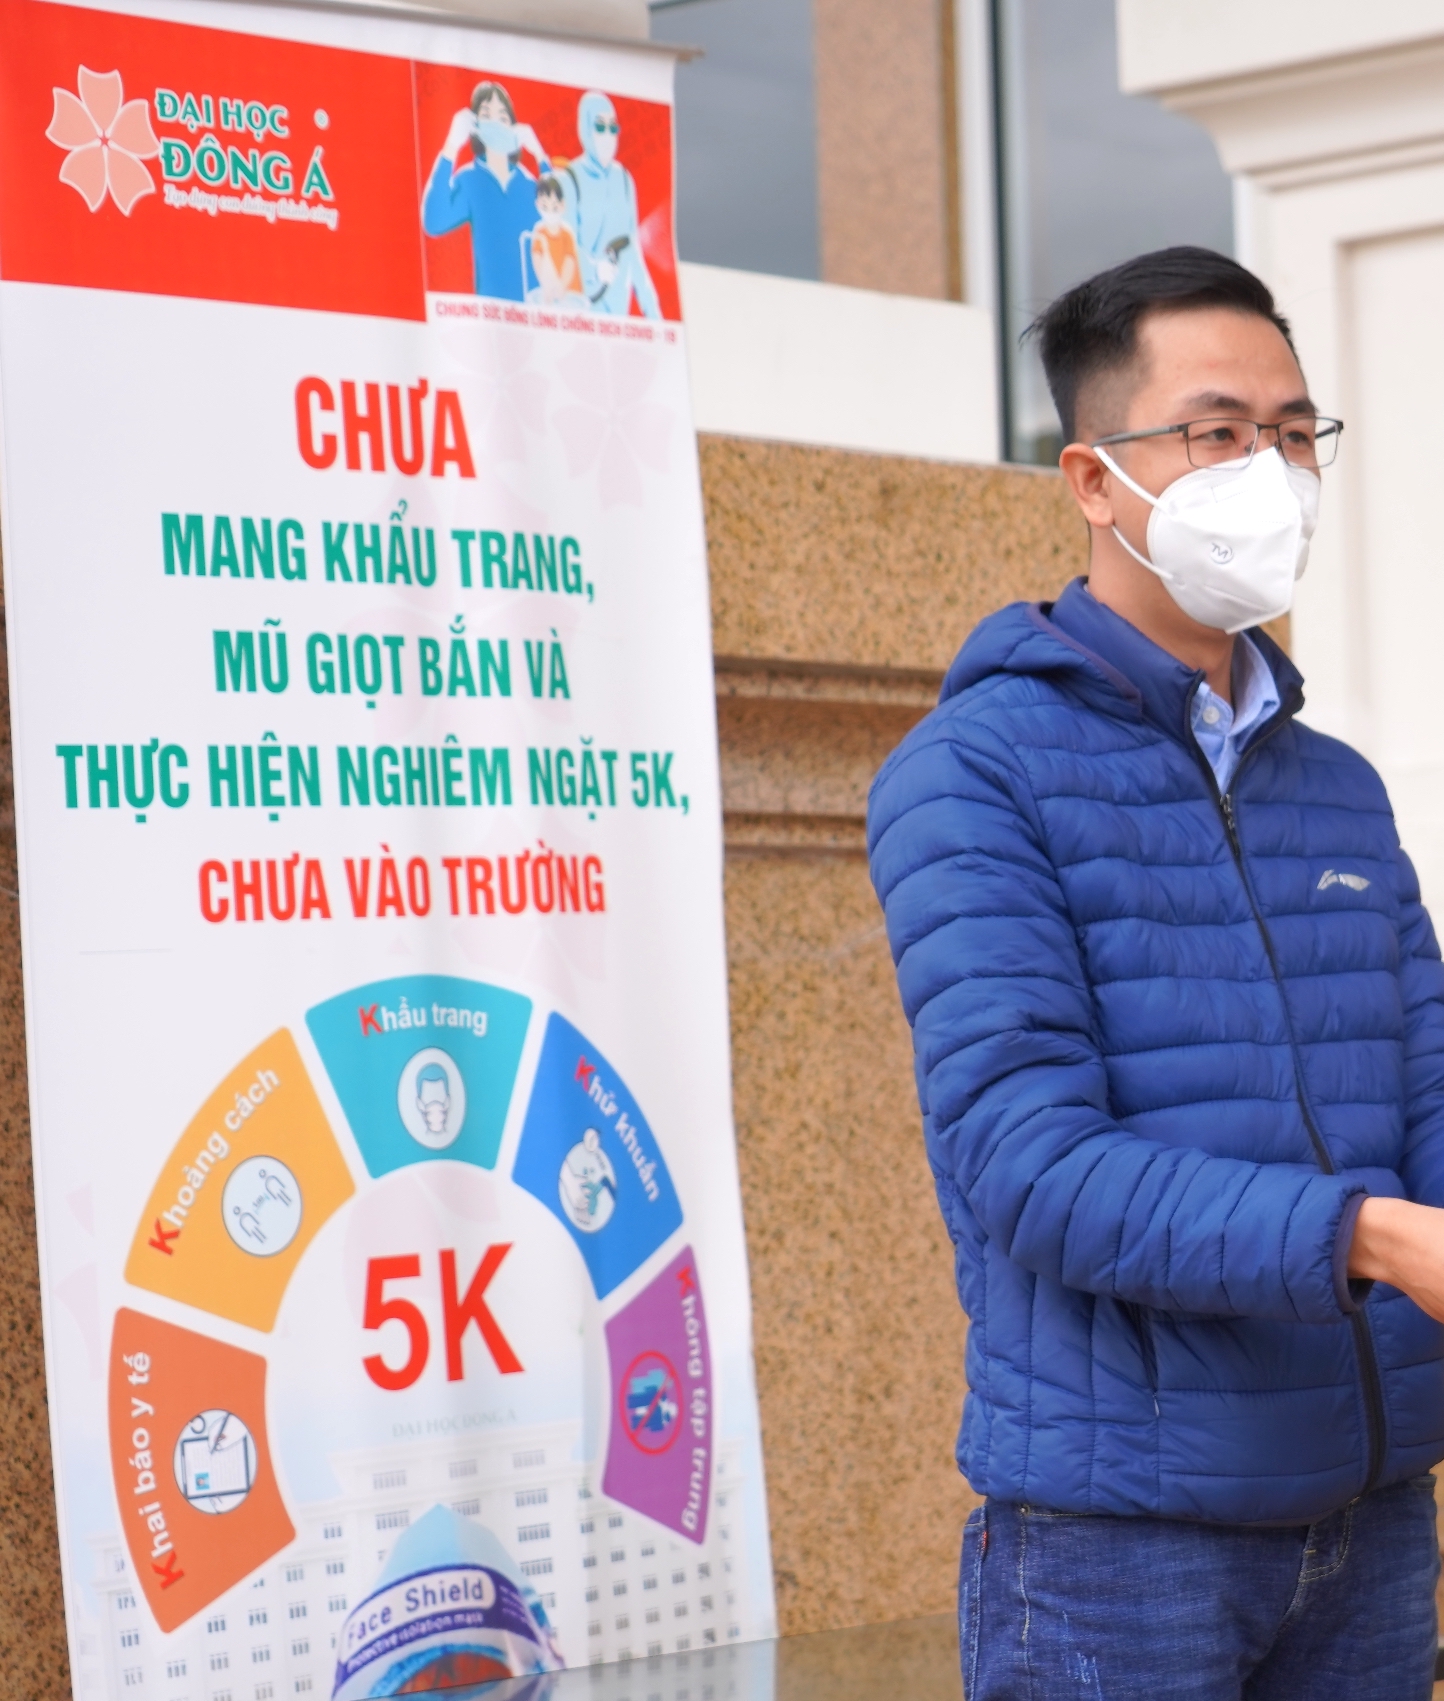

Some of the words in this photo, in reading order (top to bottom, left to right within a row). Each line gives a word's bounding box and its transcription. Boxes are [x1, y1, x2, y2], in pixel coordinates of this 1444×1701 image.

[156, 89, 213, 132] ĐẠI
[220, 97, 289, 141] HỌC
[161, 134, 292, 194] ĐÔNG
[303, 146, 334, 200] Á
[436, 301, 479, 317] CHUNG
[294, 375, 477, 478] CHƯA
[161, 512, 307, 581] MANG
[322, 499, 437, 587] KHẨU
[451, 529, 595, 603] TRANG,
[212, 618, 289, 694] MŨ
[306, 632, 404, 710] GIỌT
[419, 614, 512, 697] BẮN
[524, 629, 571, 700] VÀ
[56, 739, 190, 824] THỰC
[207, 731, 322, 822] HIỆN
[337, 734, 512, 807] NGHIÊM
[528, 736, 618, 821] NGẶT
[630, 752, 690, 816] 5K,
[198, 852, 332, 923] CHƯA
[344, 838, 430, 918] VÀO
[441, 839, 607, 915] TRƯỜNG
[358, 996, 427, 1037] Khẩu
[432, 1002, 488, 1037] trang
[148, 1131, 230, 1256] Khoảng
[224, 1068, 281, 1132] cách
[362, 1242, 524, 1390] 5K
[676, 1265, 704, 1378] Không
[123, 1352, 151, 1385] tế
[131, 1397, 155, 1418] y
[129, 1427, 156, 1495] báo
[681, 1448, 706, 1532] trung
[138, 1501, 184, 1590] Khai
[405, 1578, 484, 1612] Shield
